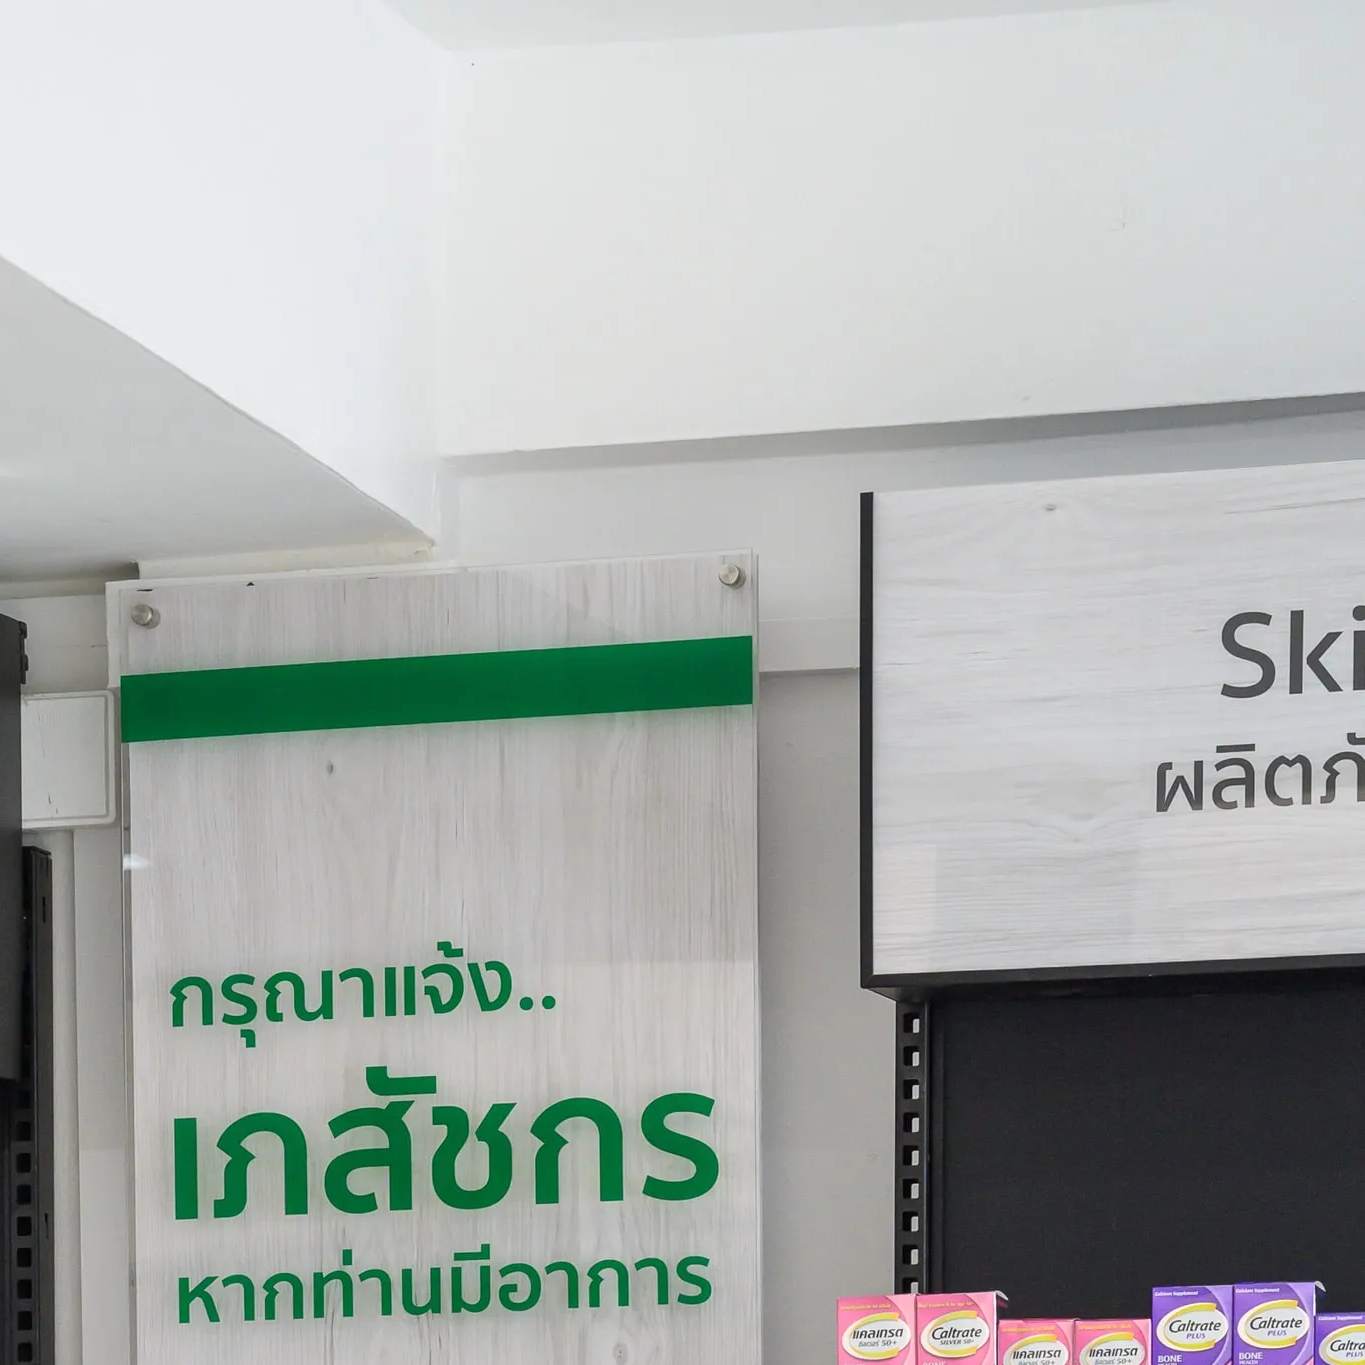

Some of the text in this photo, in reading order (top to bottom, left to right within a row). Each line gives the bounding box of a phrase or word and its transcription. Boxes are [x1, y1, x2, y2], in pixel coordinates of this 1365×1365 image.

[172, 1065, 721, 1221] เภสัชกร
[176, 1243, 713, 1325] หากท่านมีอาการ
[1168, 1320, 1222, 1334] Caltrate
[1249, 1316, 1303, 1331] Caltrate
[931, 1326, 983, 1340] Caltrate
[1186, 1332, 1206, 1340] PLUS
[1267, 1329, 1288, 1337] PLUS
[1157, 1354, 1182, 1363] BONE
[1238, 1352, 1263, 1360] BONE
